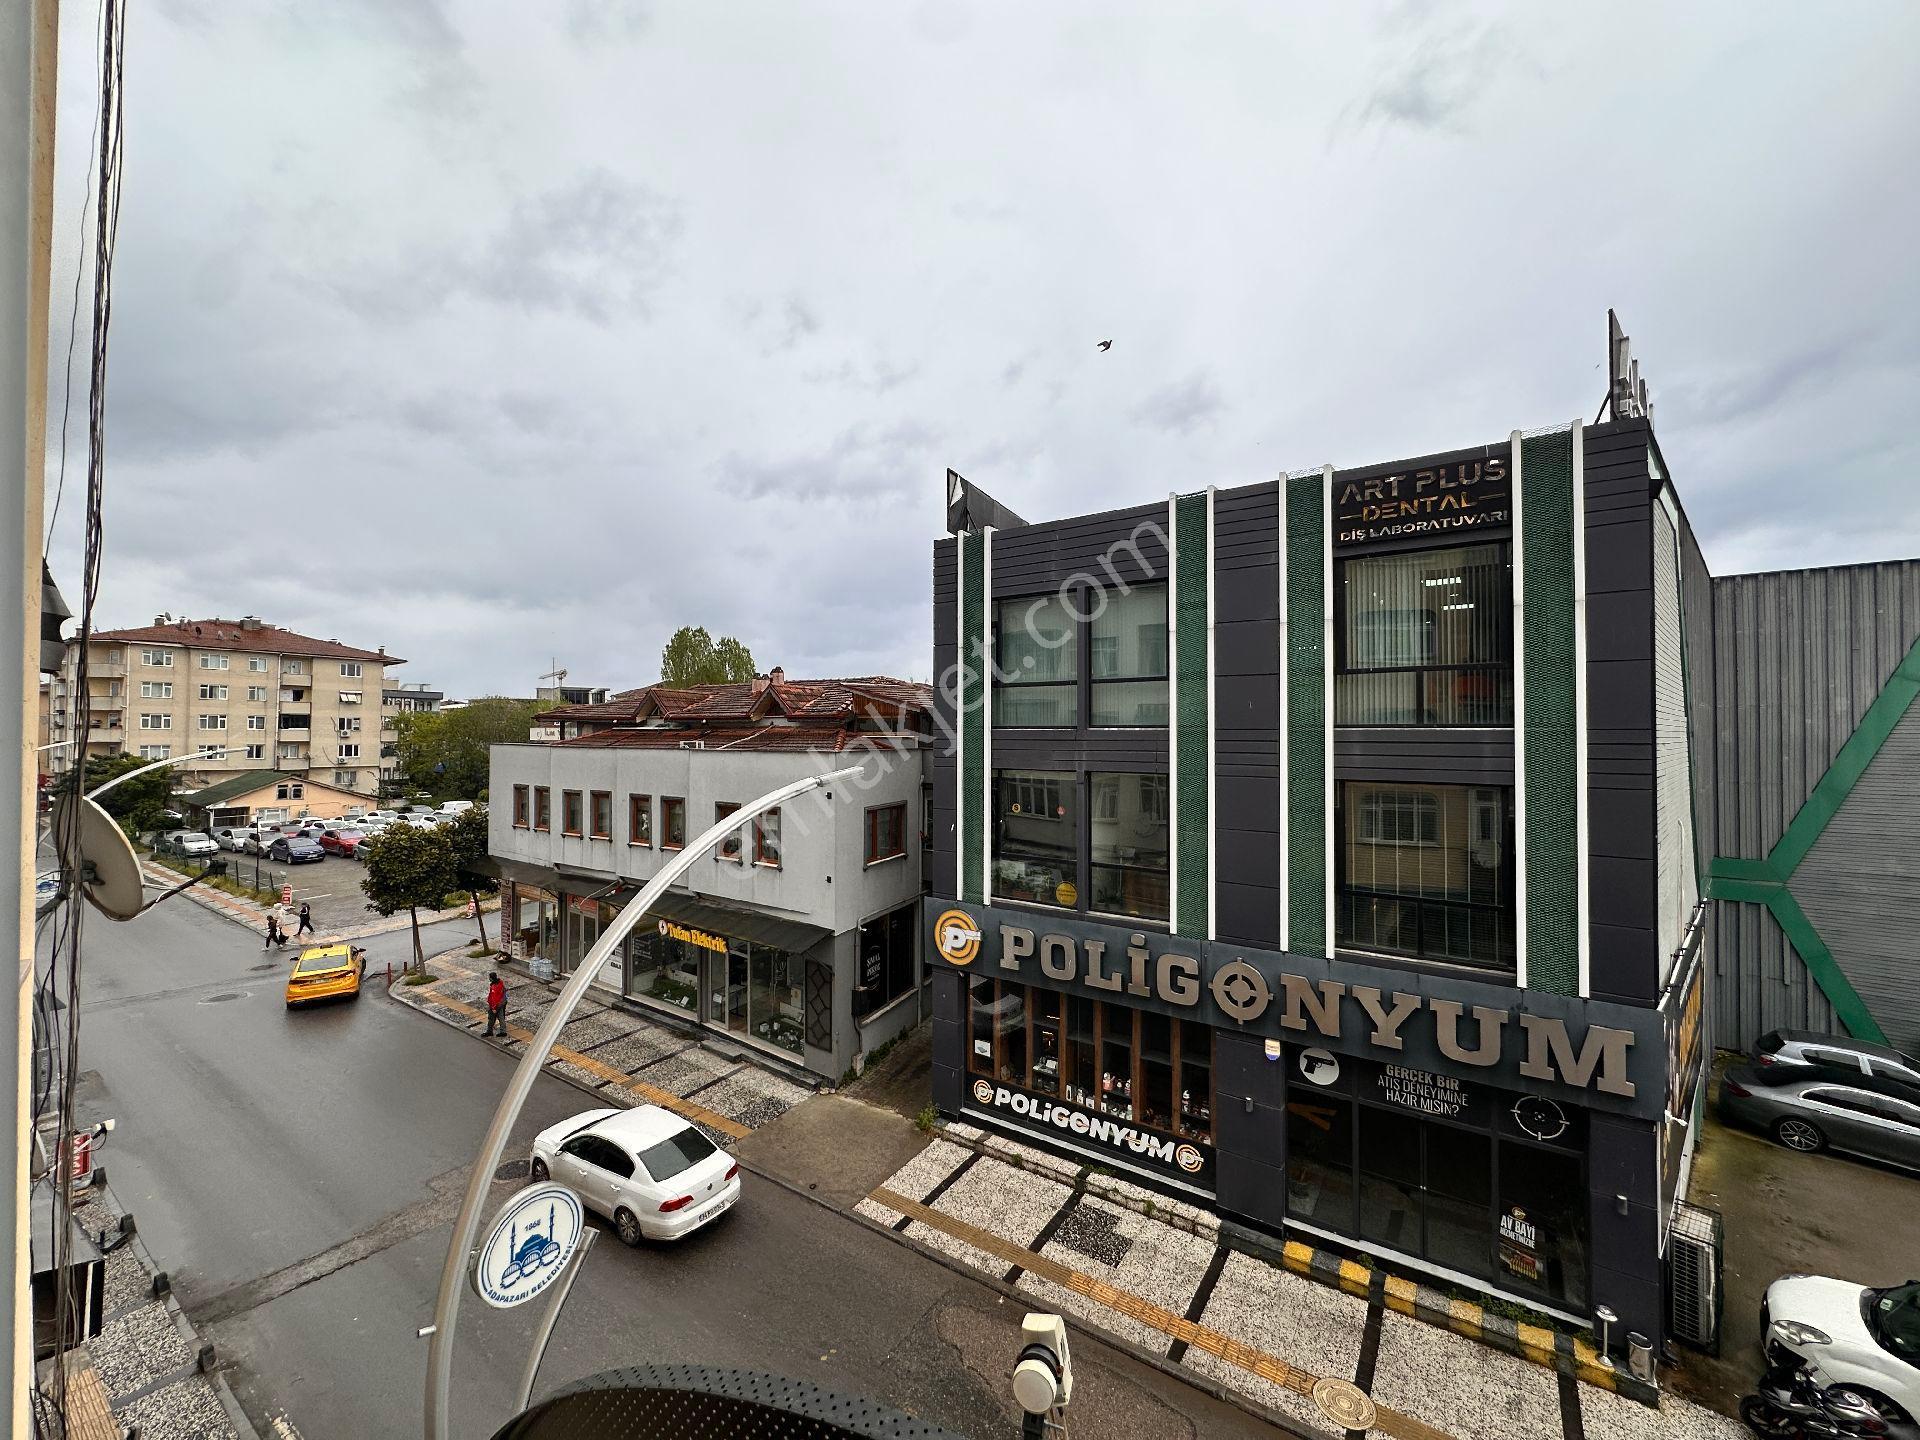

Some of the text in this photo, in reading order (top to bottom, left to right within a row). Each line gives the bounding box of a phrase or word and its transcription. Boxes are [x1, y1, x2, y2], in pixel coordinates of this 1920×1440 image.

[1339, 459, 1506, 505] ART PLUS
[1362, 491, 1478, 522] DENTAL
[1370, 510, 1508, 538] LABORATUVARI
[667, 922, 691, 943] Tufan
[1385, 1064, 1433, 1085] GERÇEK
[1386, 1088, 1460, 1117] HAZIR MISIN?
[1500, 1214, 1513, 1231] AV
[486, 1289, 530, 1303] ADAPAZARI
